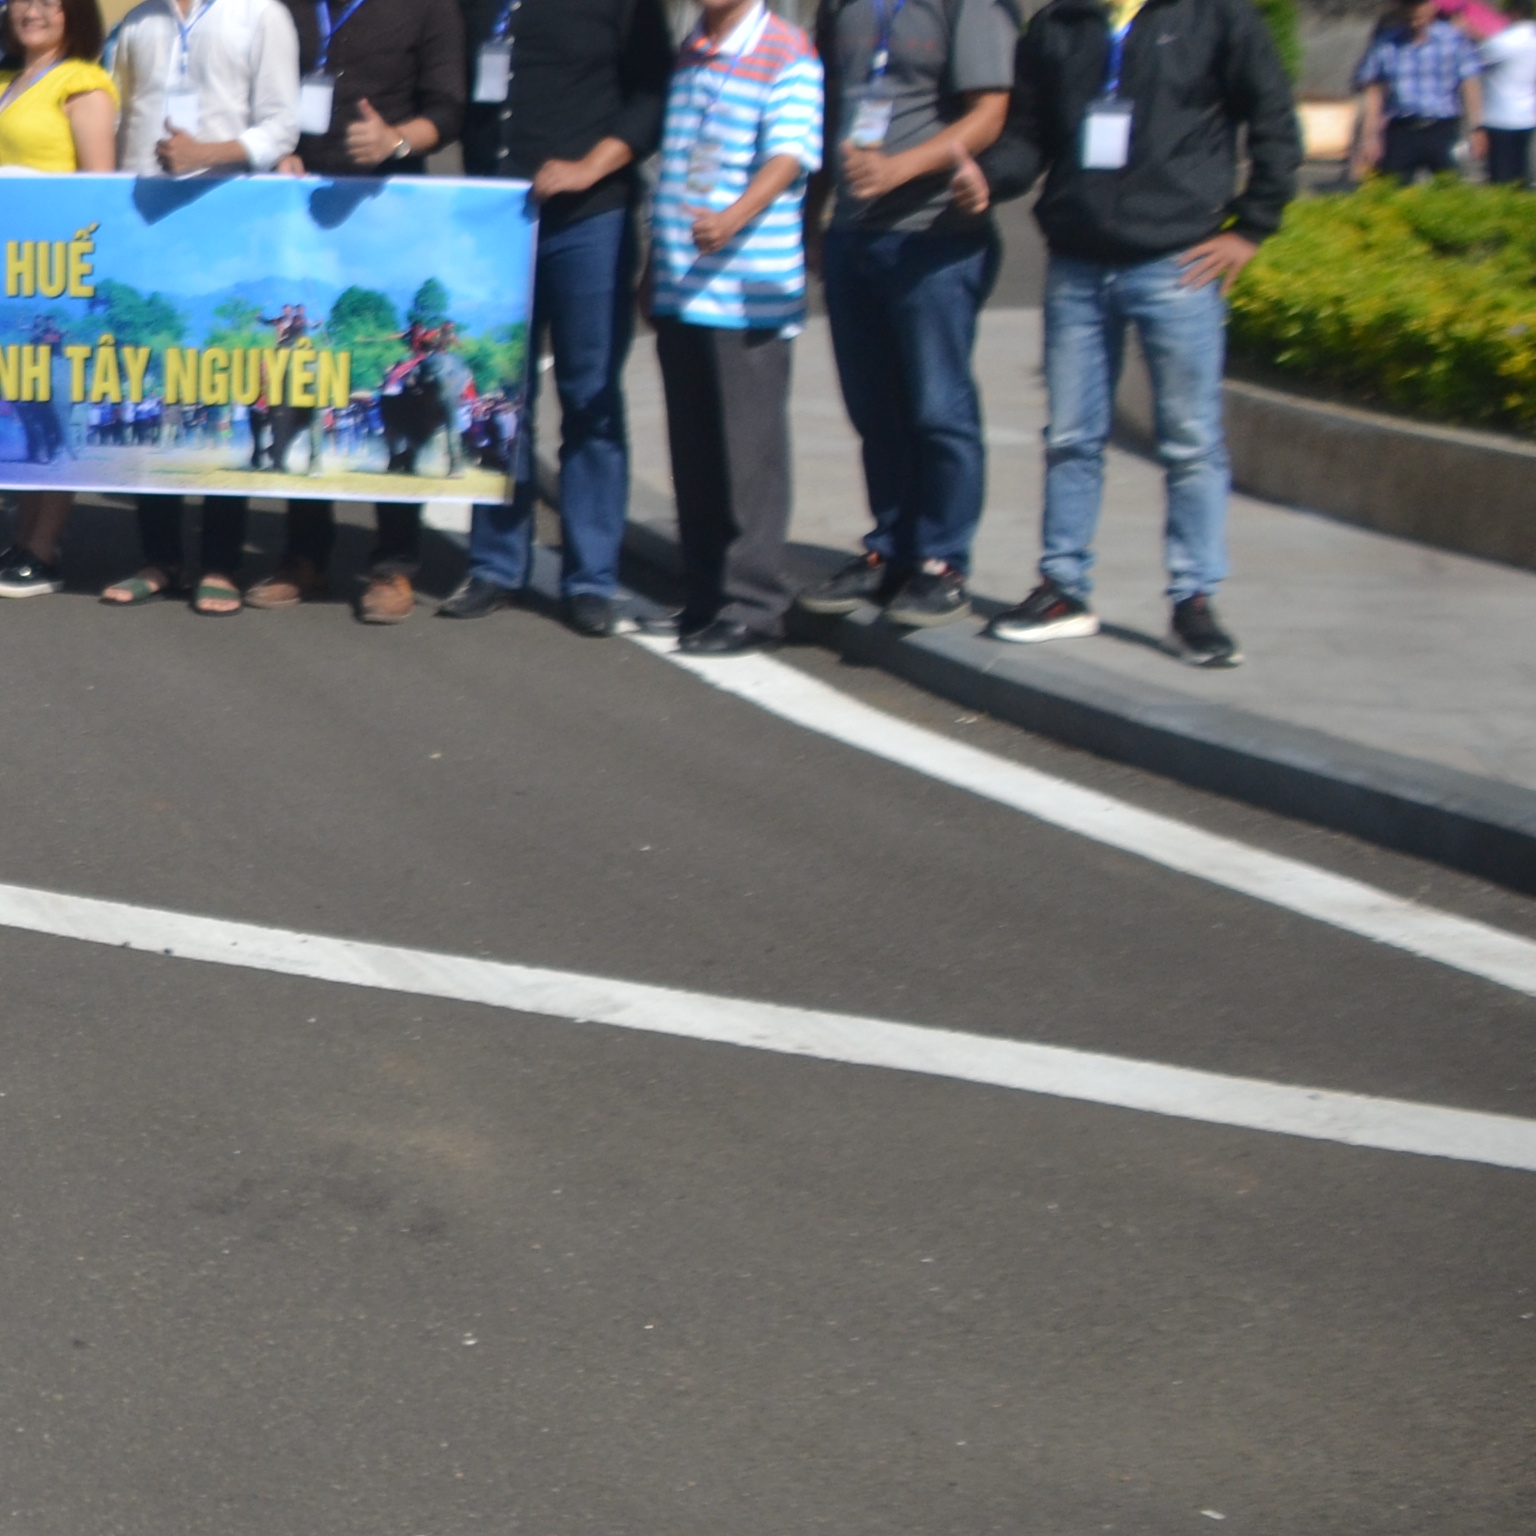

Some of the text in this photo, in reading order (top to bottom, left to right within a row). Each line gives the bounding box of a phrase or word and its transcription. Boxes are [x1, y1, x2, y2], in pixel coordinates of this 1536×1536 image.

[5, 222, 101, 299] HUẾ
[64, 333, 152, 404] TÂY
[164, 336, 352, 409] NGUYÊN
